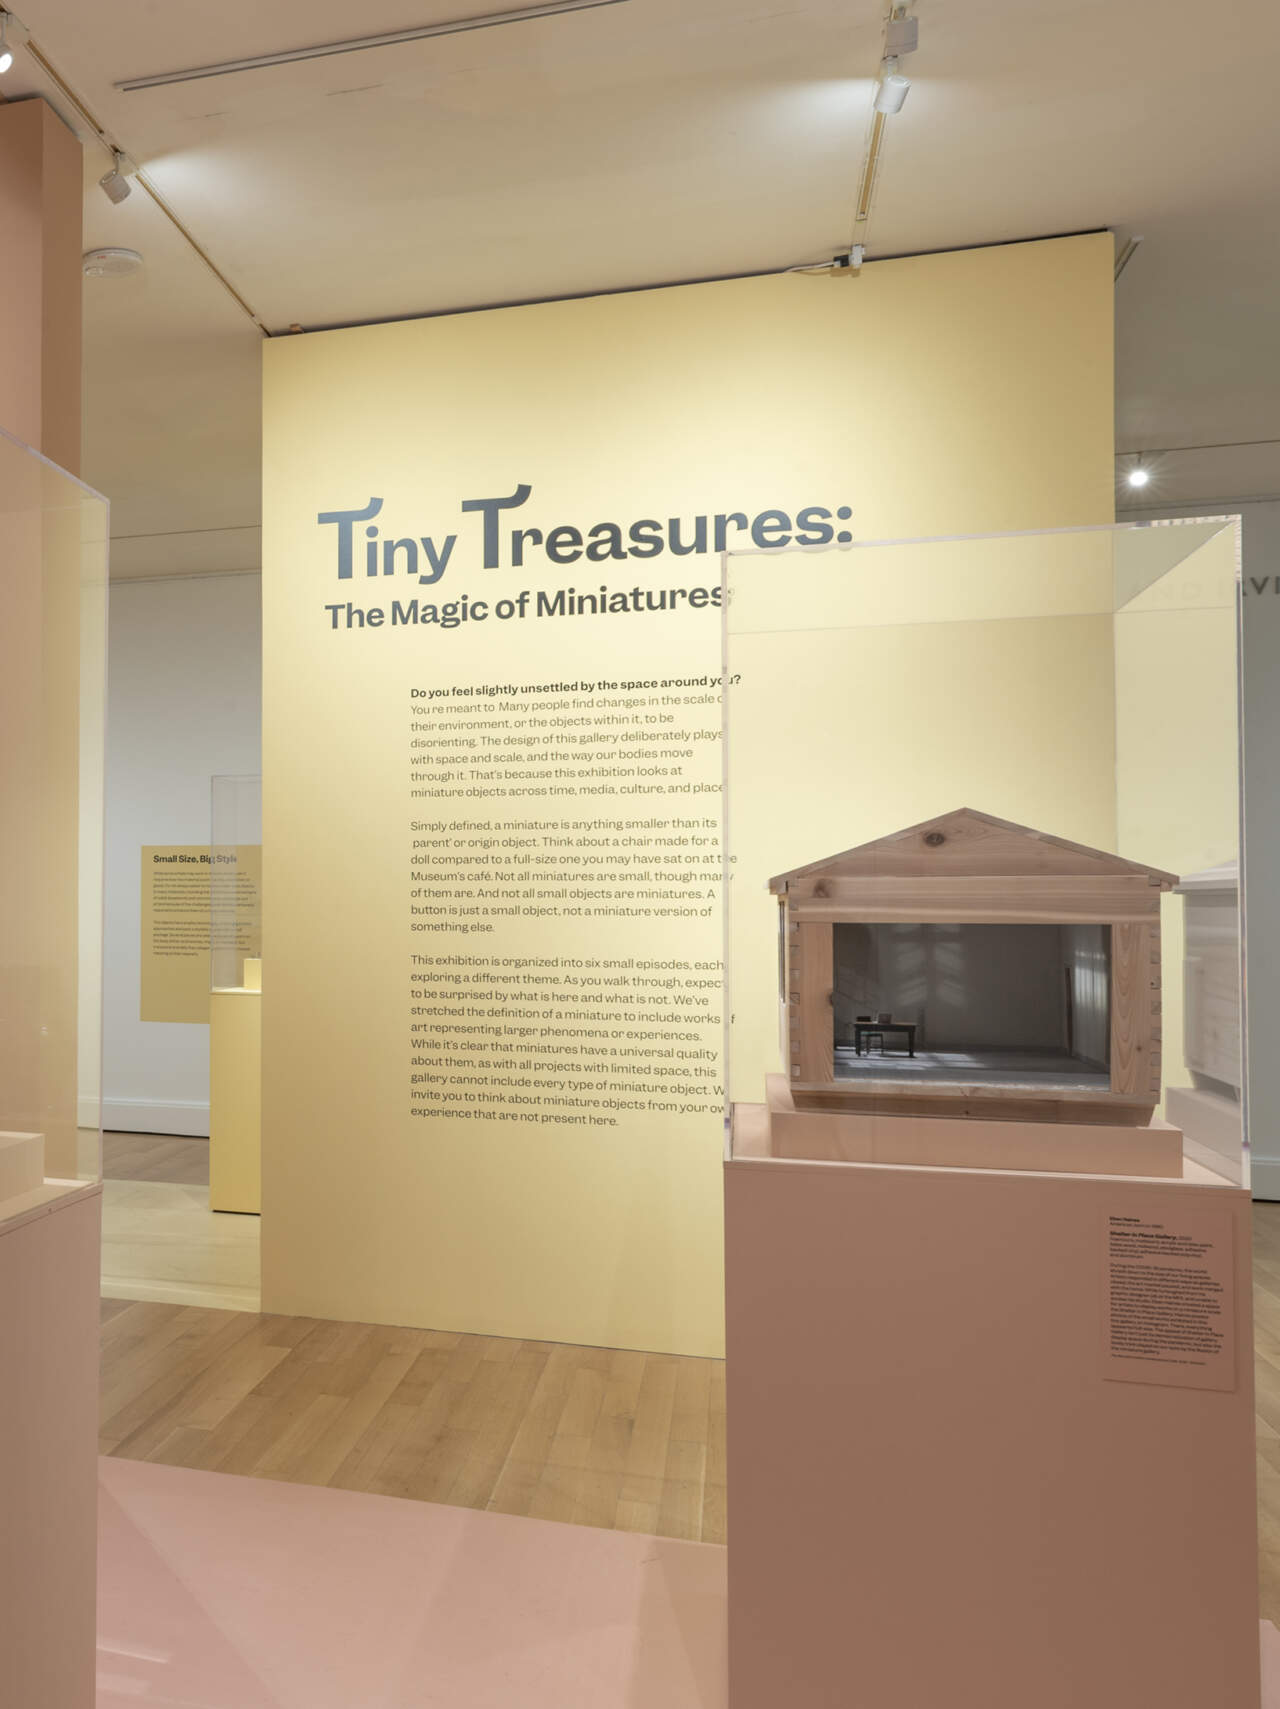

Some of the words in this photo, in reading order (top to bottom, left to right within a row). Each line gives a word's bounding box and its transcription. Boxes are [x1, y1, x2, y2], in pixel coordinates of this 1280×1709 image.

[318, 497, 457, 584] Tiny
[462, 484, 853, 569] Treasures:
[325, 602, 384, 629] The
[391, 594, 488, 628] Magic
[495, 591, 530, 620] of
[537, 585, 724, 617] Miniatures
[410, 688, 426, 698] Do
[428, 689, 449, 699] you
[451, 685, 473, 697] feel
[475, 683, 518, 697] slightly
[520, 681, 578, 693] unsettled
[580, 680, 595, 693] by
[597, 679, 618, 690] the
[620, 680, 658, 691] space
[660, 675, 707, 688] around
[445, 703, 482, 714] meant
[498, 700, 530, 713] Many
[531, 698, 570, 712] people
[571, 697, 594, 709] find
[595, 696, 646, 710] changes
[682, 693, 715, 704] scale
[410, 720, 437, 732] their
[548, 715, 592, 729] objects
[593, 713, 629, 725] within
[502, 734, 540, 747] design
[554, 732, 578, 744] this
[578, 731, 619, 745] gallery
[620, 729, 691, 744] deliberately
[410, 754, 434, 765] with
[435, 755, 469, 766] space
[618, 747, 658, 759] bodies
[660, 749, 693, 758] move
[410, 770, 454, 783] through
[468, 768, 503, 780] That's
[504, 768, 552, 779] because
[553, 767, 576, 778] this
[577, 765, 635, 778] exhibition
[636, 765, 668, 776] looks
[410, 786, 465, 798] miniature
[465, 783, 507, 799] objects
[508, 787, 547, 796] across
[410, 820, 447, 833] Simply
[503, 819, 558, 830] miniature
[571, 818, 624, 832] anything
[624, 818, 669, 829] smaller
[671, 817, 700, 828] than
[467, 836, 500, 850] origin
[541, 836, 574, 847] Think
[575, 836, 610, 847] about
[621, 835, 653, 846] chair
[654, 835, 688, 847] made
[153, 854, 177, 864] Small
[178, 854, 199, 864] Size,
[200, 854, 215, 865] Big
[410, 853, 430, 864] doll
[431, 853, 489, 866] compared
[512, 853, 557, 864] full-size
[632, 853, 661, 864] have
[411, 871, 465, 881] Museum's
[531, 870, 595, 881] miniatures
[654, 871, 697, 883] though
[422, 887, 452, 898] them
[536, 888, 567, 899] small
[568, 887, 612, 901] objects
[410, 903, 447, 916] button
[458, 904, 480, 917] just
[490, 904, 520, 915] small
[593, 905, 651, 916] miniature
[652, 905, 698, 917] version
[410, 919, 469, 934] something
[410, 954, 434, 965] This
[435, 954, 489, 966] exhibition
[501, 956, 558, 969] organized
[560, 957, 583, 968] into
[602, 957, 634, 969] small
[694, 959, 726, 973] each
[410, 971, 462, 984] exploring
[471, 972, 520, 984] different
[602, 975, 630, 986] walk
[438, 988, 493, 1001] surprised
[509, 990, 539, 1002] what
[551, 991, 579, 1002] here
[604, 992, 635, 1004] what
[672, 994, 709, 1006] We've
[410, 1004, 465, 1017] stretched
[486, 1006, 540, 1019] definition
[564, 1008, 622, 1021] miniature
[638, 1010, 681, 1023] include
[683, 1012, 720, 1024] works
[429, 1022, 503, 1037] representing
[503, 1024, 538, 1038] larger
[540, 1025, 609, 1040] phenomena
[410, 1038, 441, 1050] While
[442, 1039, 458, 1050] it's
[459, 1040, 489, 1051] clear
[490, 1041, 514, 1052] that
[515, 1041, 578, 1055] miniatures
[580, 1044, 608, 1056] have
[619, 1045, 674, 1058] universal
[676, 1047, 718, 1062] quality
[410, 1055, 443, 1067] about
[492, 1058, 517, 1069] with
[533, 1059, 582, 1073] projects
[583, 1061, 609, 1073] with
[610, 1062, 651, 1075] limited
[693, 1066, 717, 1077] this
[410, 1071, 448, 1086] gallery
[449, 1074, 488, 1086] cannot
[490, 1075, 532, 1088] include
[532, 1079, 565, 1091] every
[567, 1079, 594, 1092] type
[609, 1080, 668, 1093] miniature
[410, 1088, 441, 1100] invite
[477, 1091, 507, 1103] think
[507, 1092, 541, 1105] about
[543, 1094, 600, 1108] miniature
[601, 1097, 646, 1111] objects
[647, 1099, 677, 1111] from
[679, 1103, 708, 1115] your
[410, 1105, 472, 1120] experience
[473, 1108, 497, 1120] that
[541, 1113, 587, 1126] present
